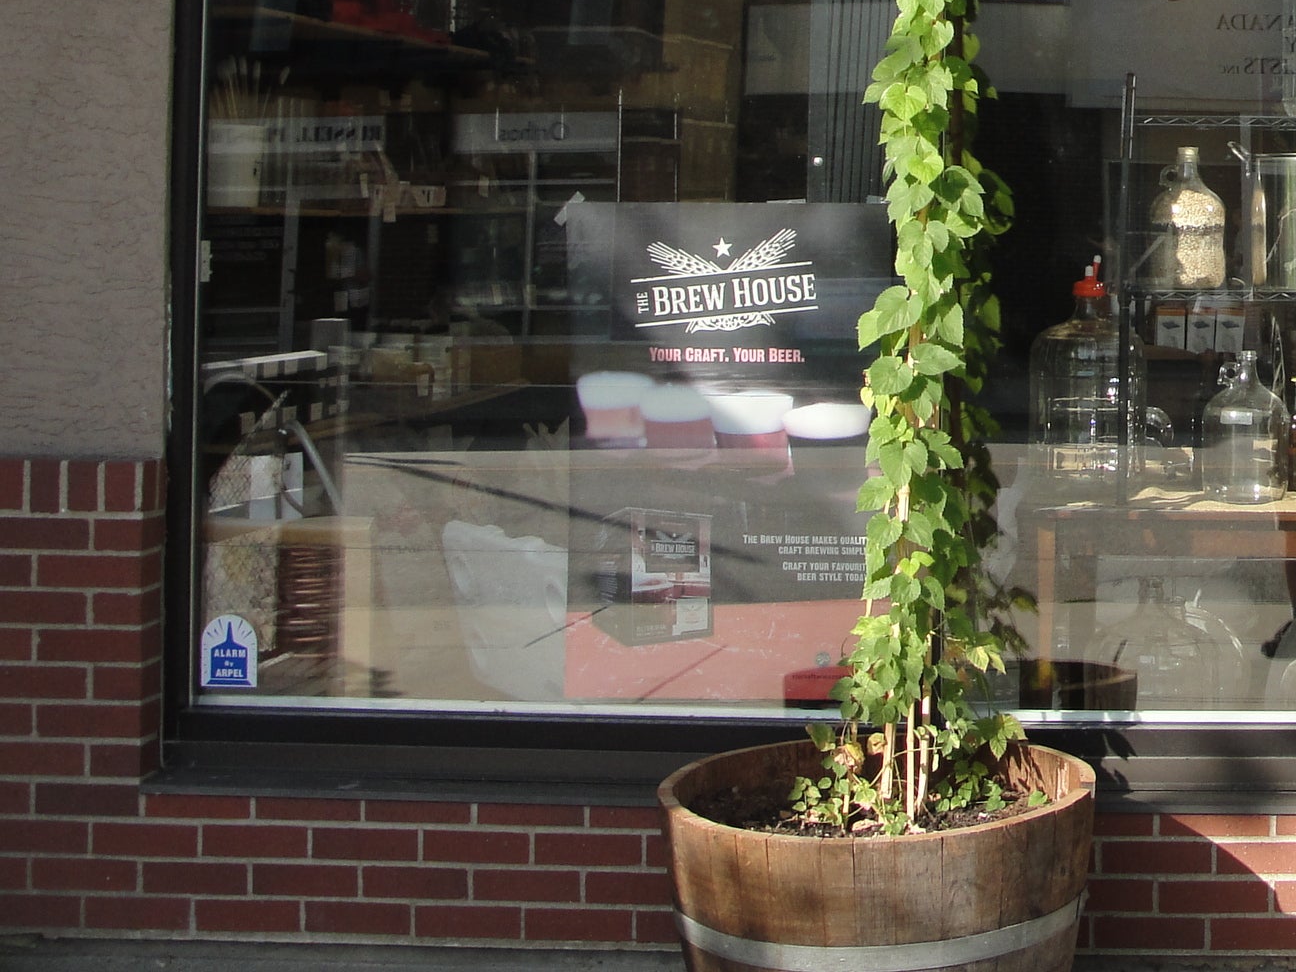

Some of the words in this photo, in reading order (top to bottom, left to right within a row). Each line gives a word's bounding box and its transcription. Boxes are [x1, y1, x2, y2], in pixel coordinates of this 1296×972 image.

[652, 282, 727, 317] BREW
[731, 273, 817, 309] HOUSE
[636, 291, 650, 314] THE
[649, 347, 682, 363] YOUR
[685, 347, 729, 363] CRAFT.
[733, 347, 765, 363] YOUR
[769, 347, 806, 363] BEER.
[742, 534, 758, 544] THE
[760, 534, 783, 544] BREW
[785, 535, 810, 545] HOUSE
[812, 536, 838, 545] MAKES
[840, 536, 867, 546] QUALIT
[778, 546, 802, 555] CRAFT
[805, 546, 839, 556] BREWING
[841, 546, 867, 556] SIMPL
[782, 561, 807, 571] CRAFT
[809, 562, 830, 571] YOUR
[832, 562, 867, 572] FAVOURIT
[797, 573, 817, 581] BEER
[819, 573, 843, 582] STYLE
[213, 648, 246, 658] ALARM
[215, 668, 244, 678] ARPEL
